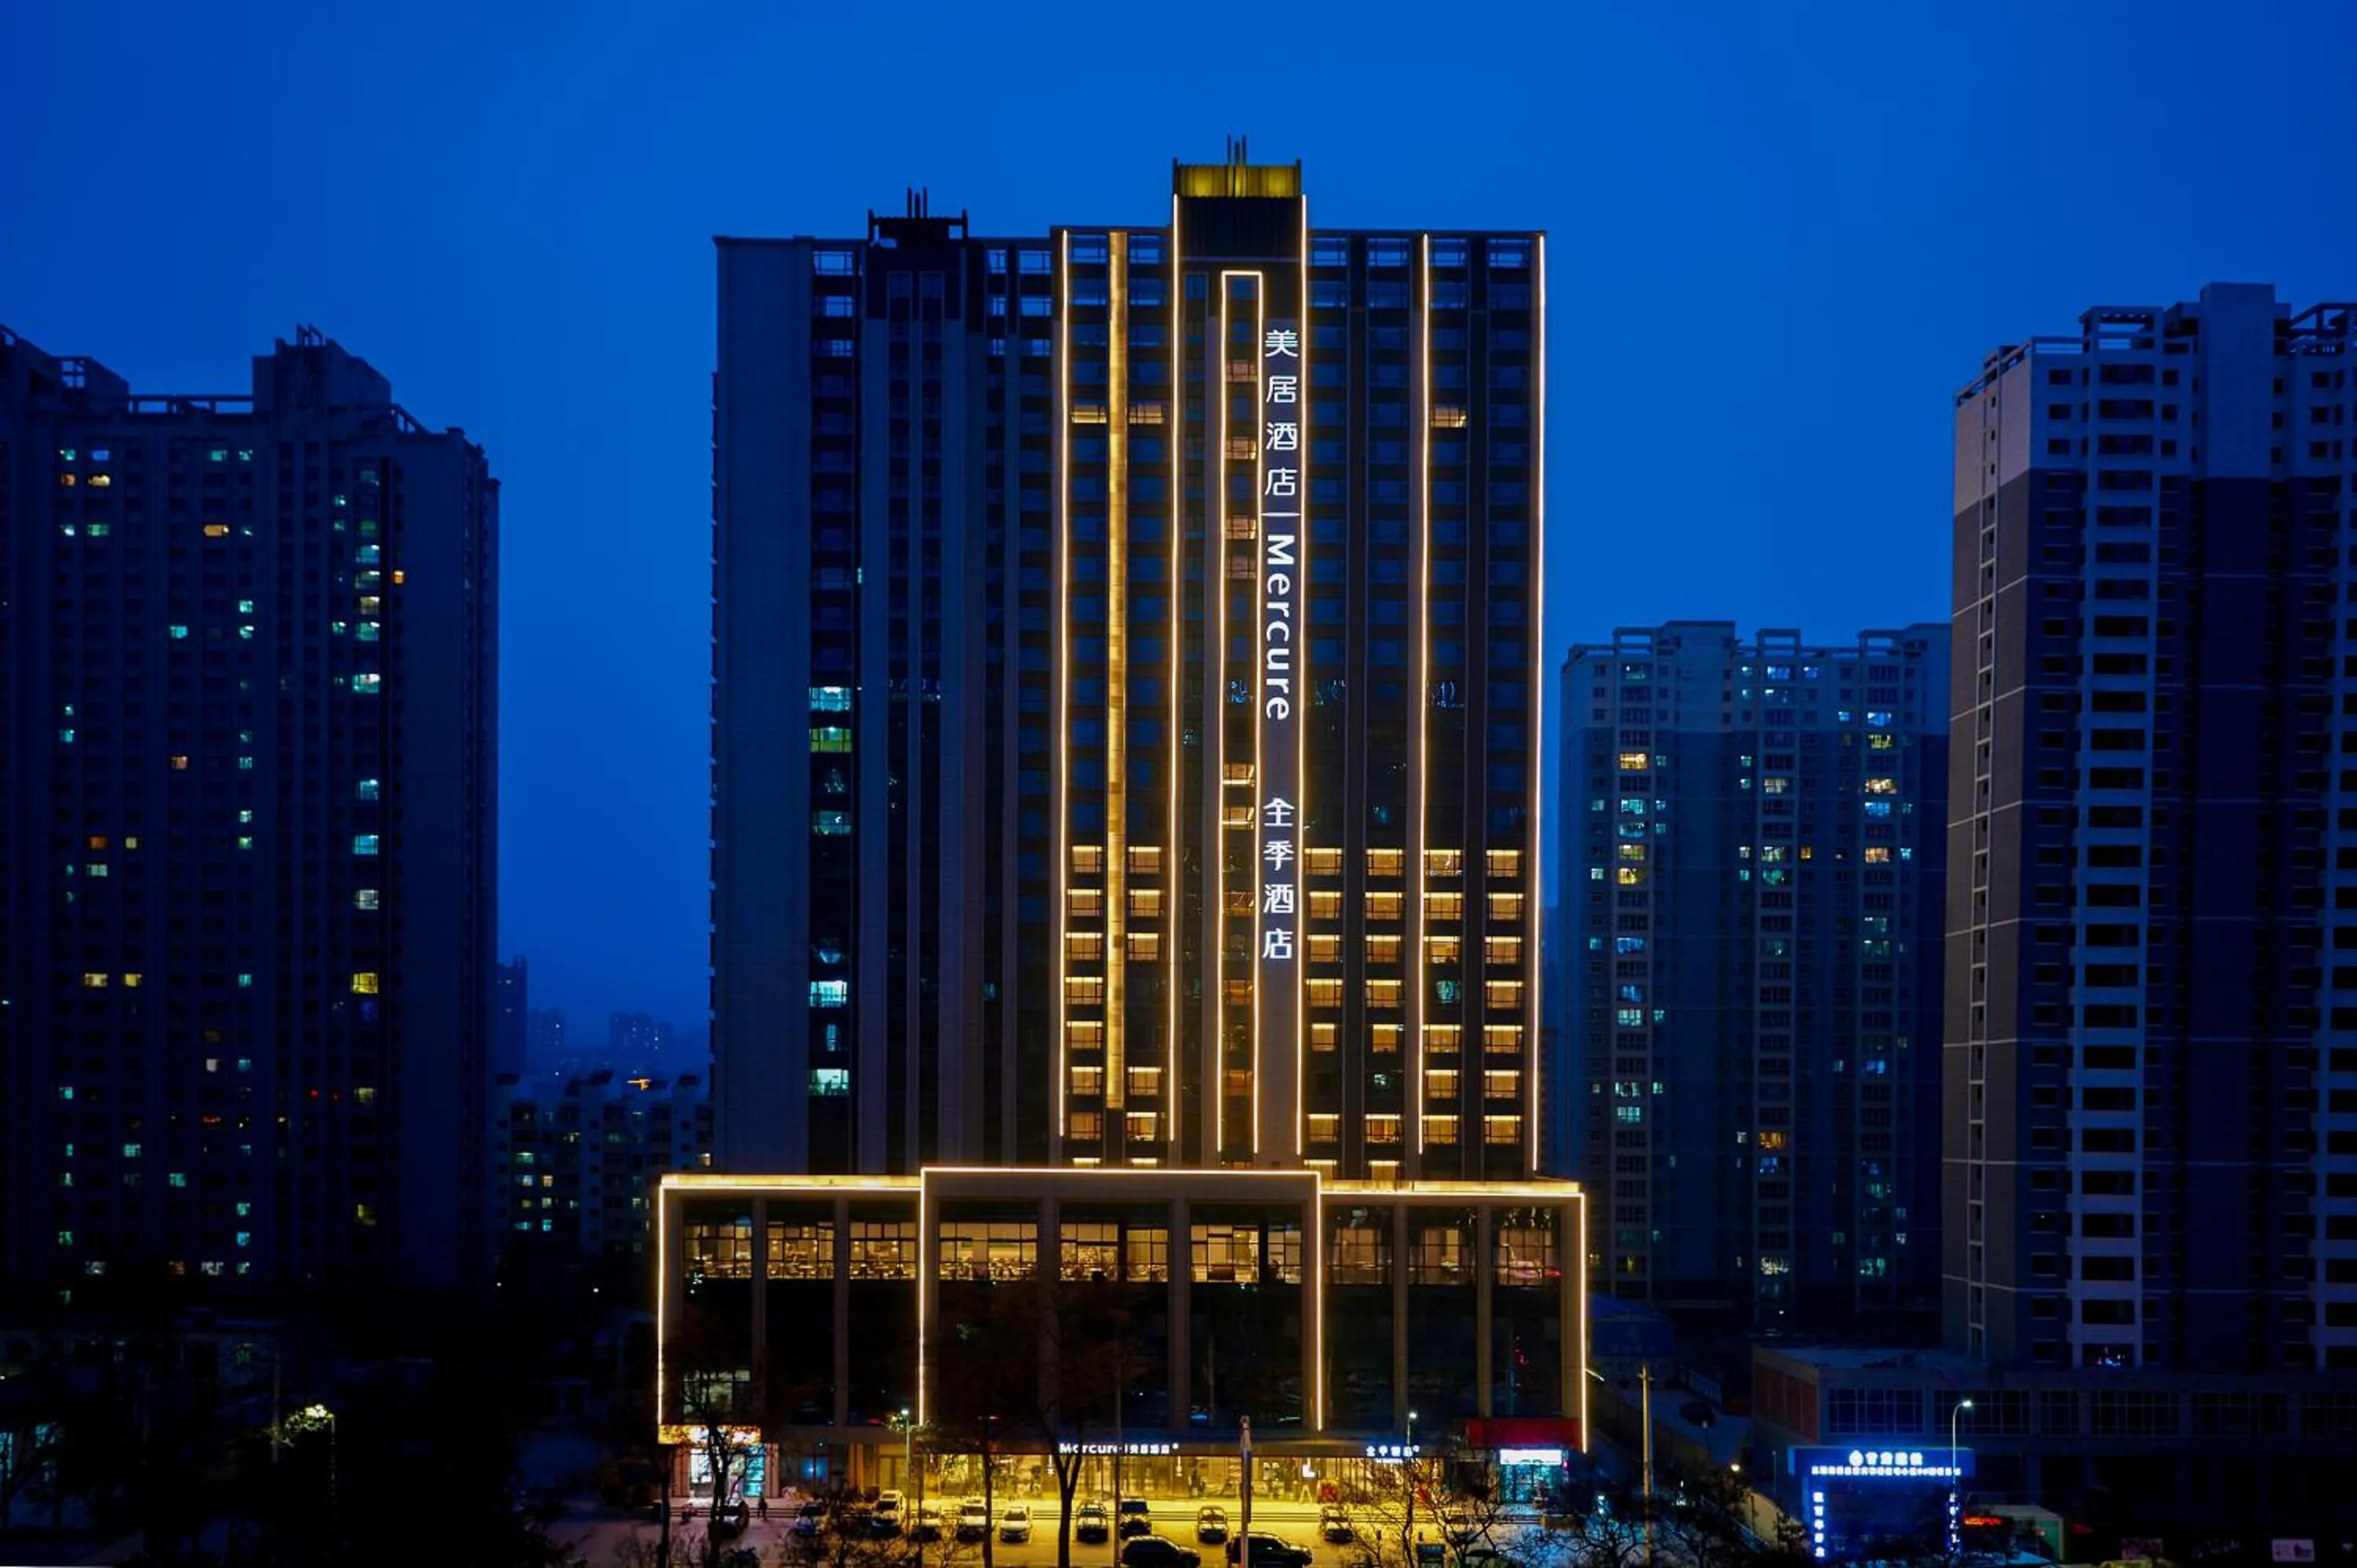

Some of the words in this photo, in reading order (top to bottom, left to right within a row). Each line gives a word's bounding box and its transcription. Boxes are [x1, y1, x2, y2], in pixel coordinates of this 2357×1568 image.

[1264, 329, 1299, 496] 美居酒店
[1266, 534, 1296, 721] Mercure
[1262, 797, 1296, 960] 全季酒店
